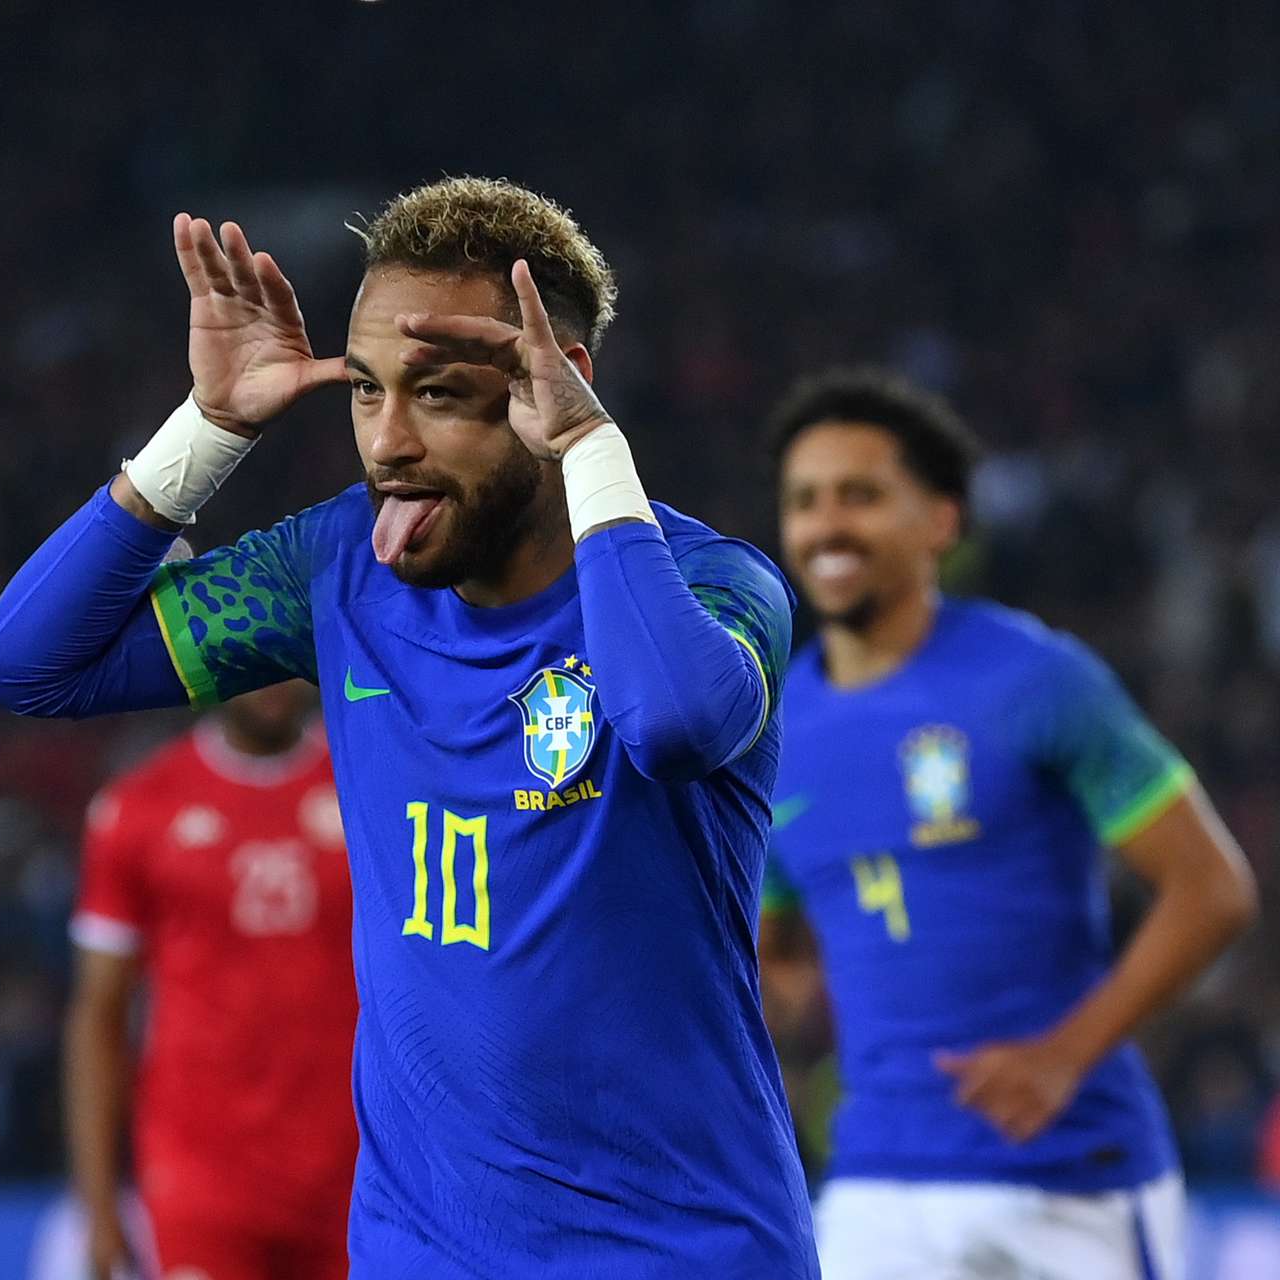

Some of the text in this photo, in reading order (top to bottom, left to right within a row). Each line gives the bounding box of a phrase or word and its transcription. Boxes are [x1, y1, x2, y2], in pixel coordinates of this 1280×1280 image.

[545, 716, 573, 731] CBF
[514, 779, 603, 811] BRASIL
[401, 800, 490, 951] 10
[849, 851, 912, 943] 4
